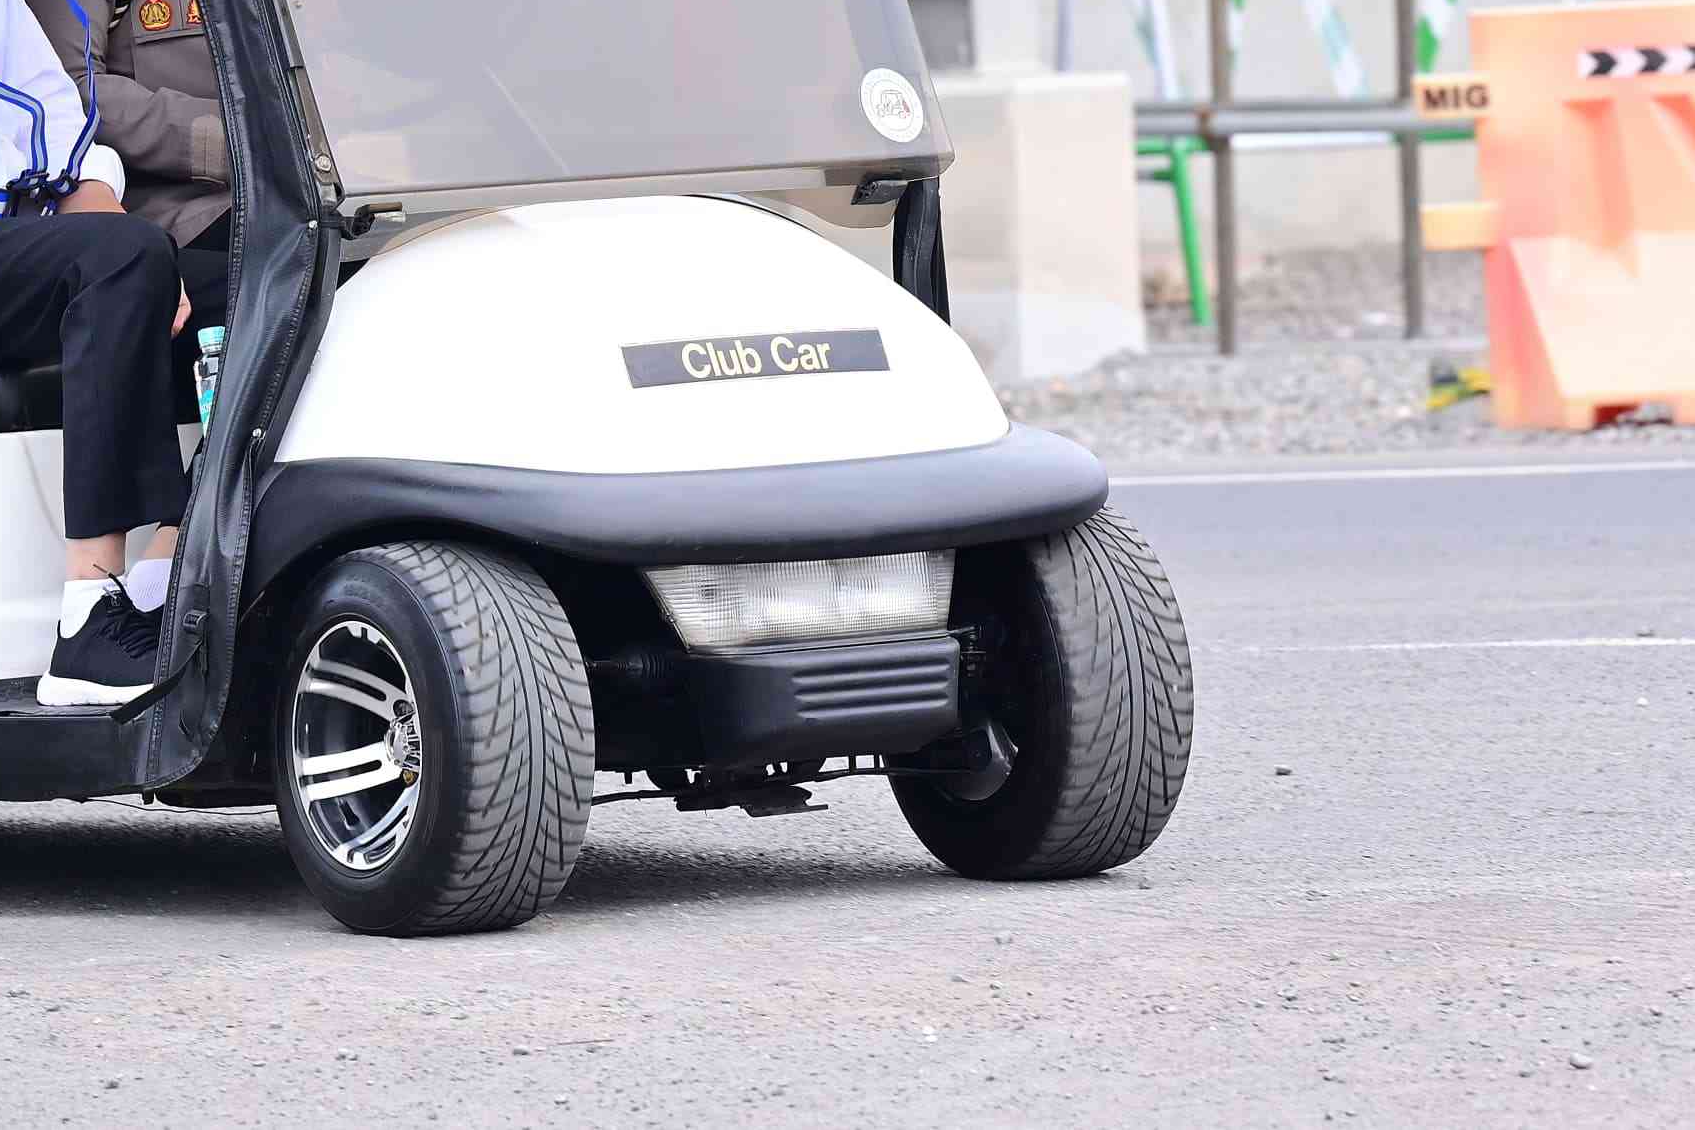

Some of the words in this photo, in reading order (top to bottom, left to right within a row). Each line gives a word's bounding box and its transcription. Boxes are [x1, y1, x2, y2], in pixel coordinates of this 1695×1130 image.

[1423, 83, 1489, 110] MIG
[681, 339, 762, 379] Club
[770, 336, 830, 372] Car
